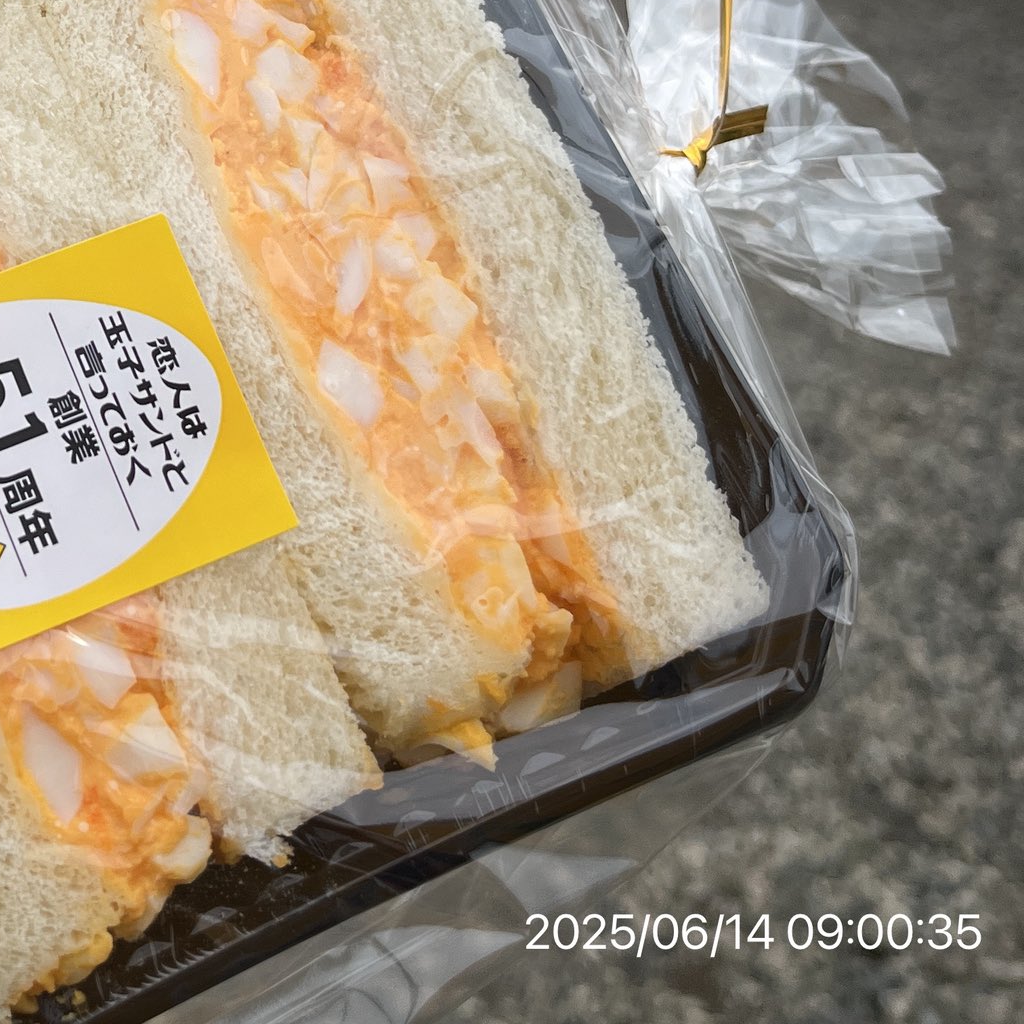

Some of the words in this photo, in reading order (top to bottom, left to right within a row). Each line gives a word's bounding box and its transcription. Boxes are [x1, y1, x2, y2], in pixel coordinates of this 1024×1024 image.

[47, 390, 101, 464] 創業
[74, 340, 152, 486] 言っておく
[98, 311, 189, 491] 玉子サンドと
[145, 336, 207, 439] 恋人は
